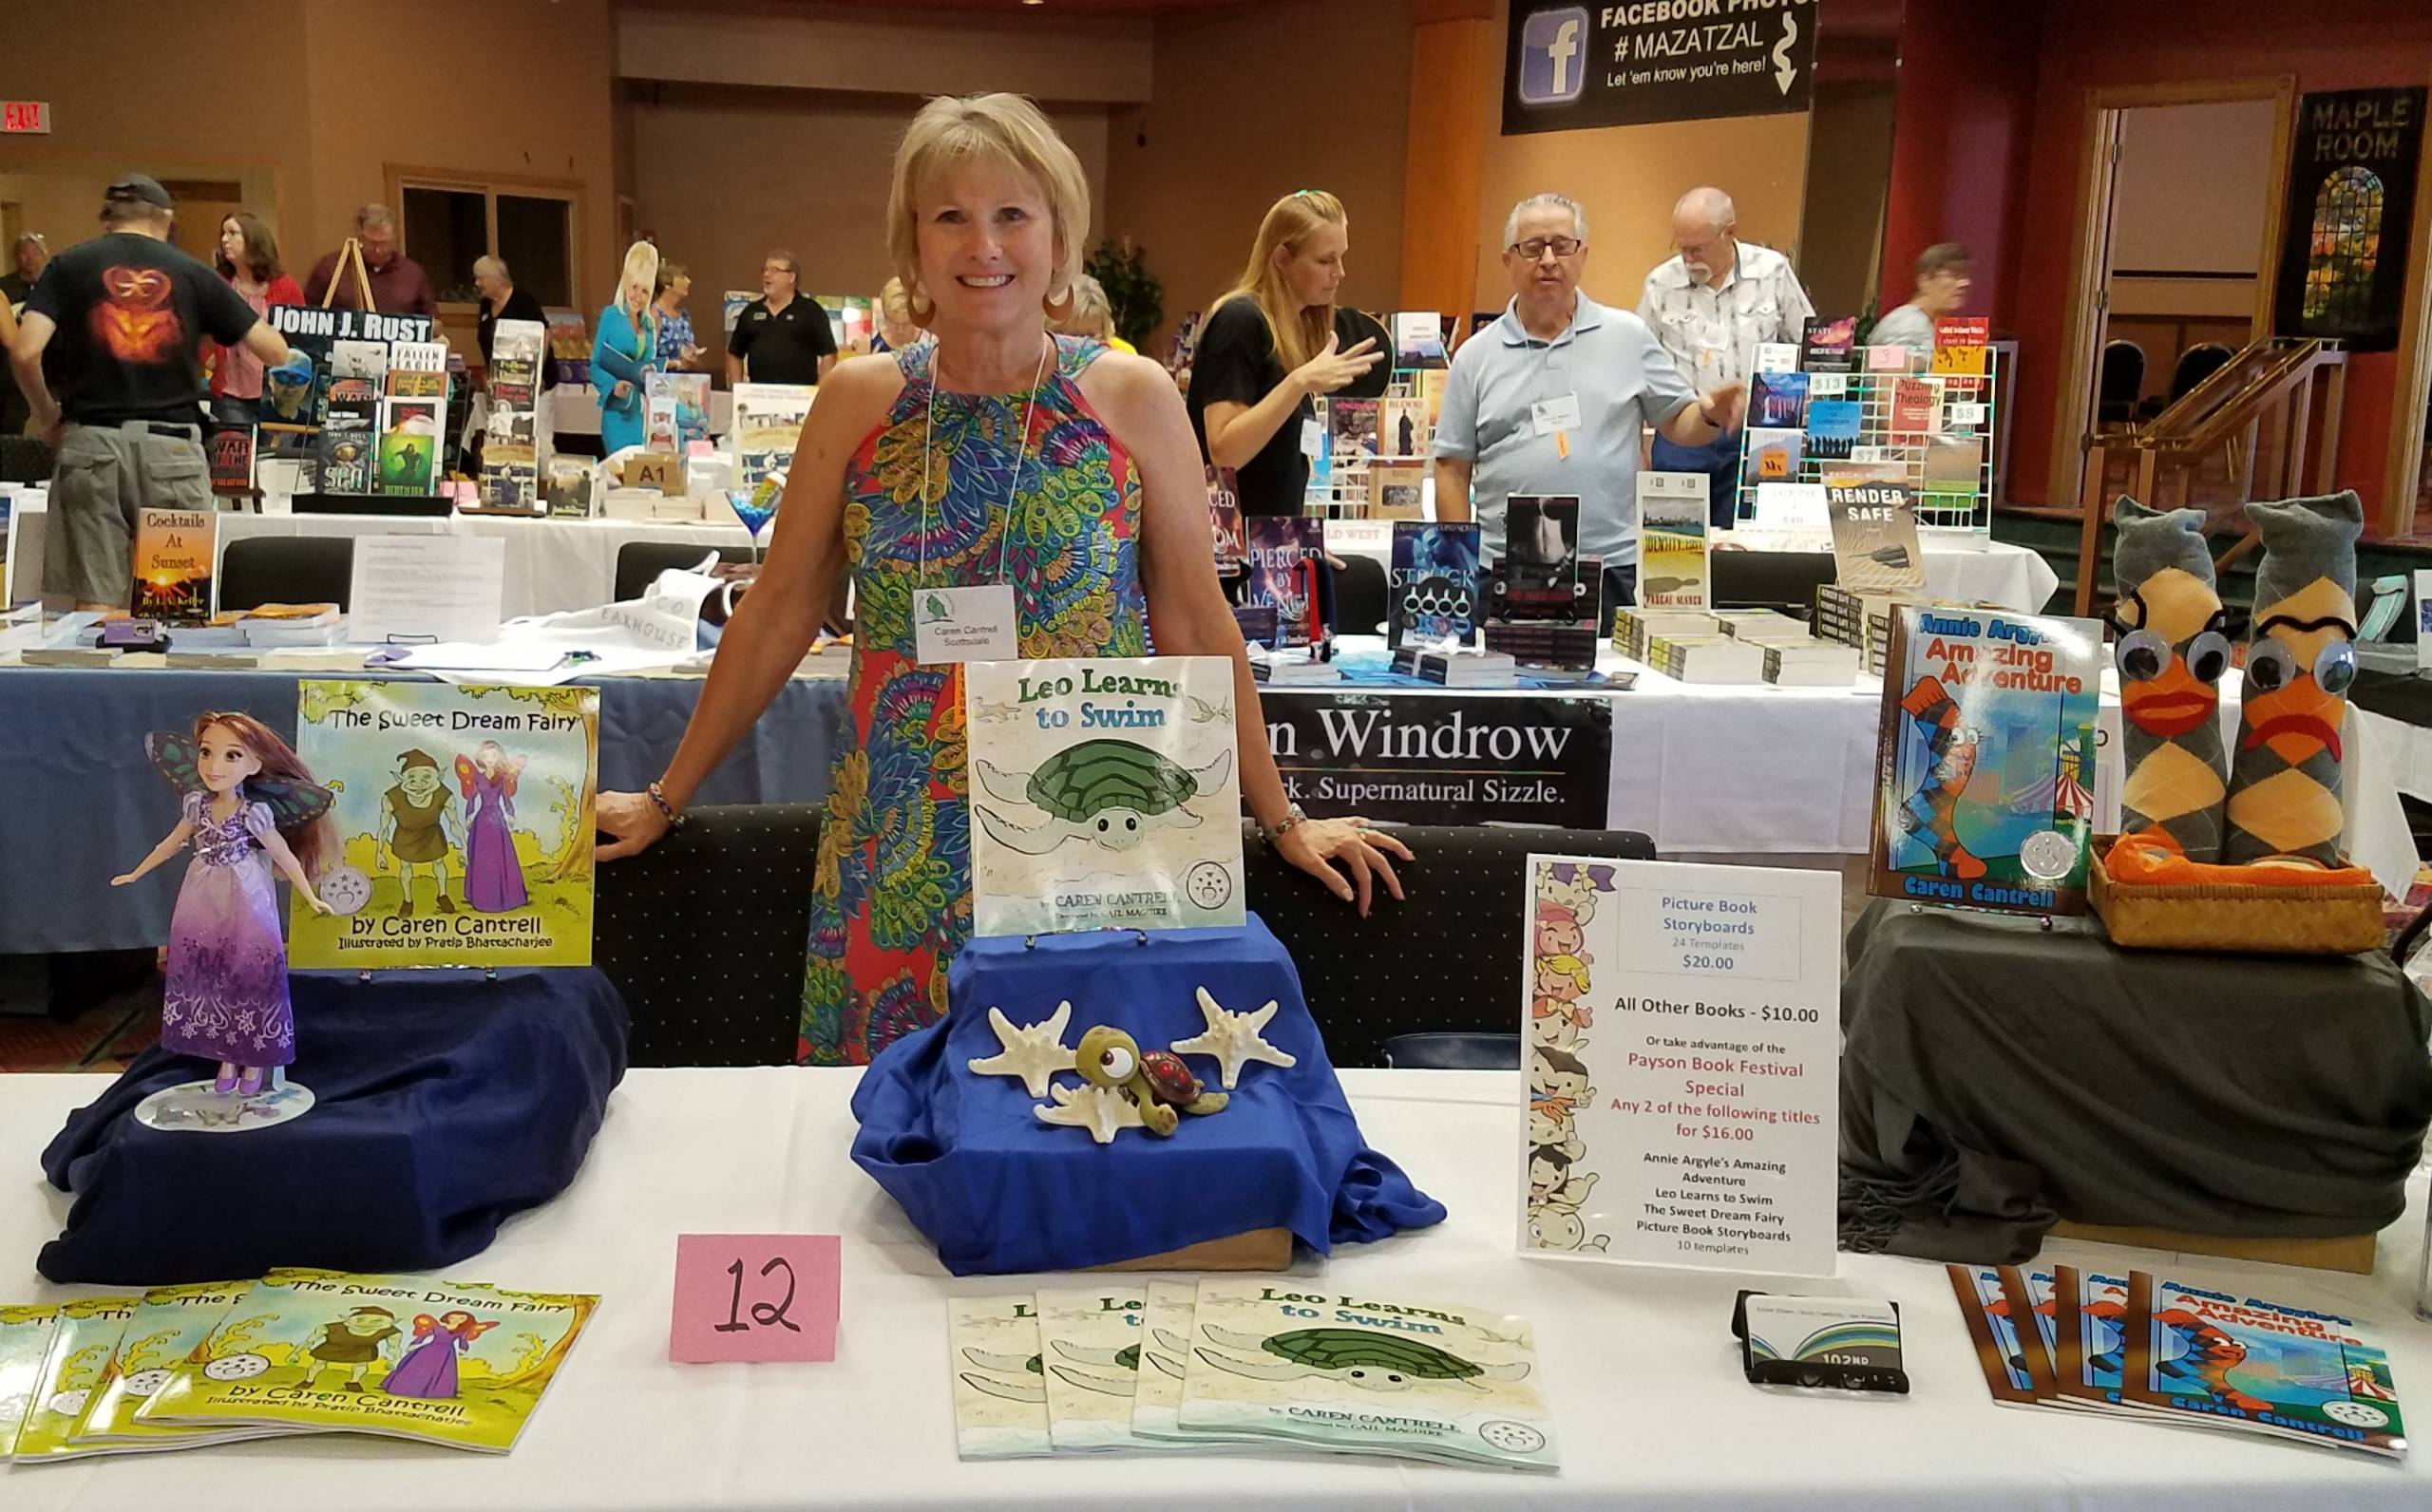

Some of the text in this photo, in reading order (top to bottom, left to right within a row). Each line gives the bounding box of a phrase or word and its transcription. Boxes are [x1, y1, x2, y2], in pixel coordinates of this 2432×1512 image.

[1601, 0, 1720, 28] FACEBOOK
[1634, 21, 1764, 60] MAZATZAL
[1607, 55, 1766, 87] Let 'em know you're here!
[5, 102, 40, 129] EXIT
[2311, 97, 2410, 131] MAPLE
[2314, 130, 2399, 161] ROOM
[273, 306, 429, 342] JOHN J. RUST
[1895, 392, 1941, 407] Theology
[639, 465, 665, 482] A1
[1832, 488, 1903, 504] RENDER
[147, 513, 204, 528] Cocktails
[1848, 507, 1894, 521] SAFE
[165, 533, 182, 548] At
[1347, 529, 1381, 540] WEST
[151, 554, 196, 569] Sunset
[1250, 547, 1322, 569] PIERCED
[1277, 574, 1292, 587] BY
[1391, 568, 1475, 589] STRCK
[934, 625, 998, 636] Caren Cantrell
[1919, 613, 1981, 637] Annie
[1926, 637, 2053, 673] Amzing
[1941, 662, 2081, 694] Aenture
[1017, 677, 1074, 704] Leo
[330, 709, 580, 731] The Sweet Dream Fairy
[1036, 700, 1167, 729] to Swim
[1316, 708, 1571, 760] Windrow
[1319, 775, 1473, 806] Supernatural
[1483, 778, 1566, 804] Sizzle.
[1054, 894, 1103, 908] CAREN
[1903, 875, 2055, 909] Caren Cantrell
[1662, 897, 1758, 914] Picture Book
[352, 916, 541, 936] by Caren Cantrell
[1663, 917, 1755, 935] Storyboards
[338, 936, 553, 950] Illustrated by Pratip Bhattacharjee
[1672, 937, 1745, 951] 24 Templates
[1682, 954, 1734, 970] $20.00
[1614, 997, 1636, 1011] All
[1642, 998, 1690, 1014] Other
[1695, 1002, 1745, 1018] Books
[1761, 1005, 1818, 1023] $10.00
[1646, 1035, 1786, 1054] Or take advantage of the
[1628, 1052, 1803, 1077] Payson Book Festival
[1685, 1079, 1744, 1097] Special
[1610, 1098, 1820, 1125] Any 2 of the following titles
[1676, 1123, 1754, 1141] for $16.00
[1643, 1152, 1786, 1175] Annie Argyle's Amazing
[1682, 1172, 1746, 1187] Adventure
[1655, 1187, 1774, 1205] Leo Learns to Swim
[1644, 1203, 1785, 1226] The Sweet Dream Fairy
[1637, 1220, 1792, 1241] Picture Book Storyboards
[1678, 1239, 1749, 1256] 10 templates
[177, 1295, 226, 1306] The
[291, 1280, 568, 1314] The Sweet Dream Fairy
[714, 1257, 801, 1333] 12
[1100, 1297, 1146, 1312] Le
[2161, 1281, 2352, 1326] Annie Argyle's
[98, 1310, 135, 1320] Th
[1259, 1288, 1466, 1326] Leo Learns
[2176, 1295, 2325, 1332] Amazing
[1280, 1304, 1444, 1335] to Swim
[2195, 1308, 2363, 1346] Adventure
[205, 1396, 288, 1408] Illustrated
[228, 1385, 466, 1417] by Caren Cantrell
[1288, 1407, 1353, 1421] CAREN
[1358, 1414, 1463, 1433] CANTRELL
[2170, 1394, 2366, 1442] Caren Cantrell
